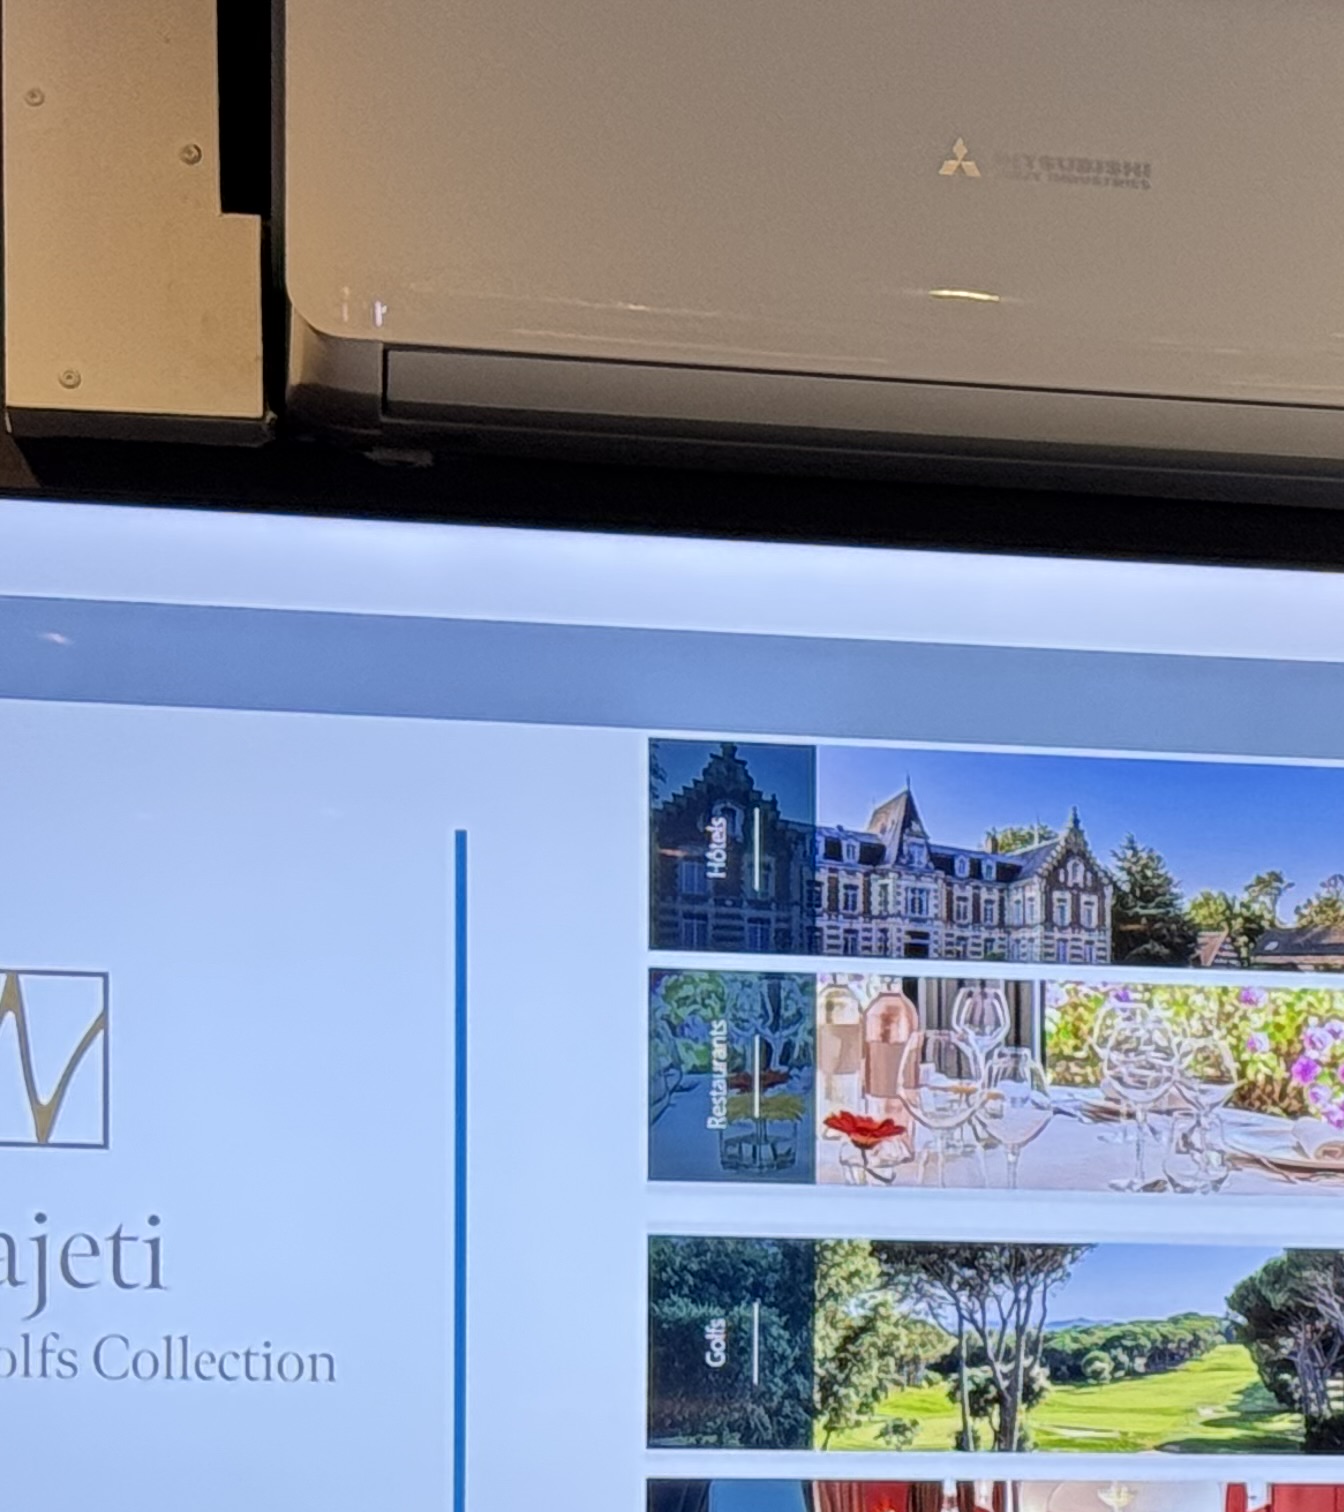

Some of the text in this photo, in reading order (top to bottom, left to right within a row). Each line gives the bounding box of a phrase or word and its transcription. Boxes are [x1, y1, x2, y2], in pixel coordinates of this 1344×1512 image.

[706, 816, 728, 879] Hôtels
[706, 1018, 728, 1130] Restaurants
[92, 1333, 337, 1384] Collection
[704, 1317, 727, 1369] Golfs
